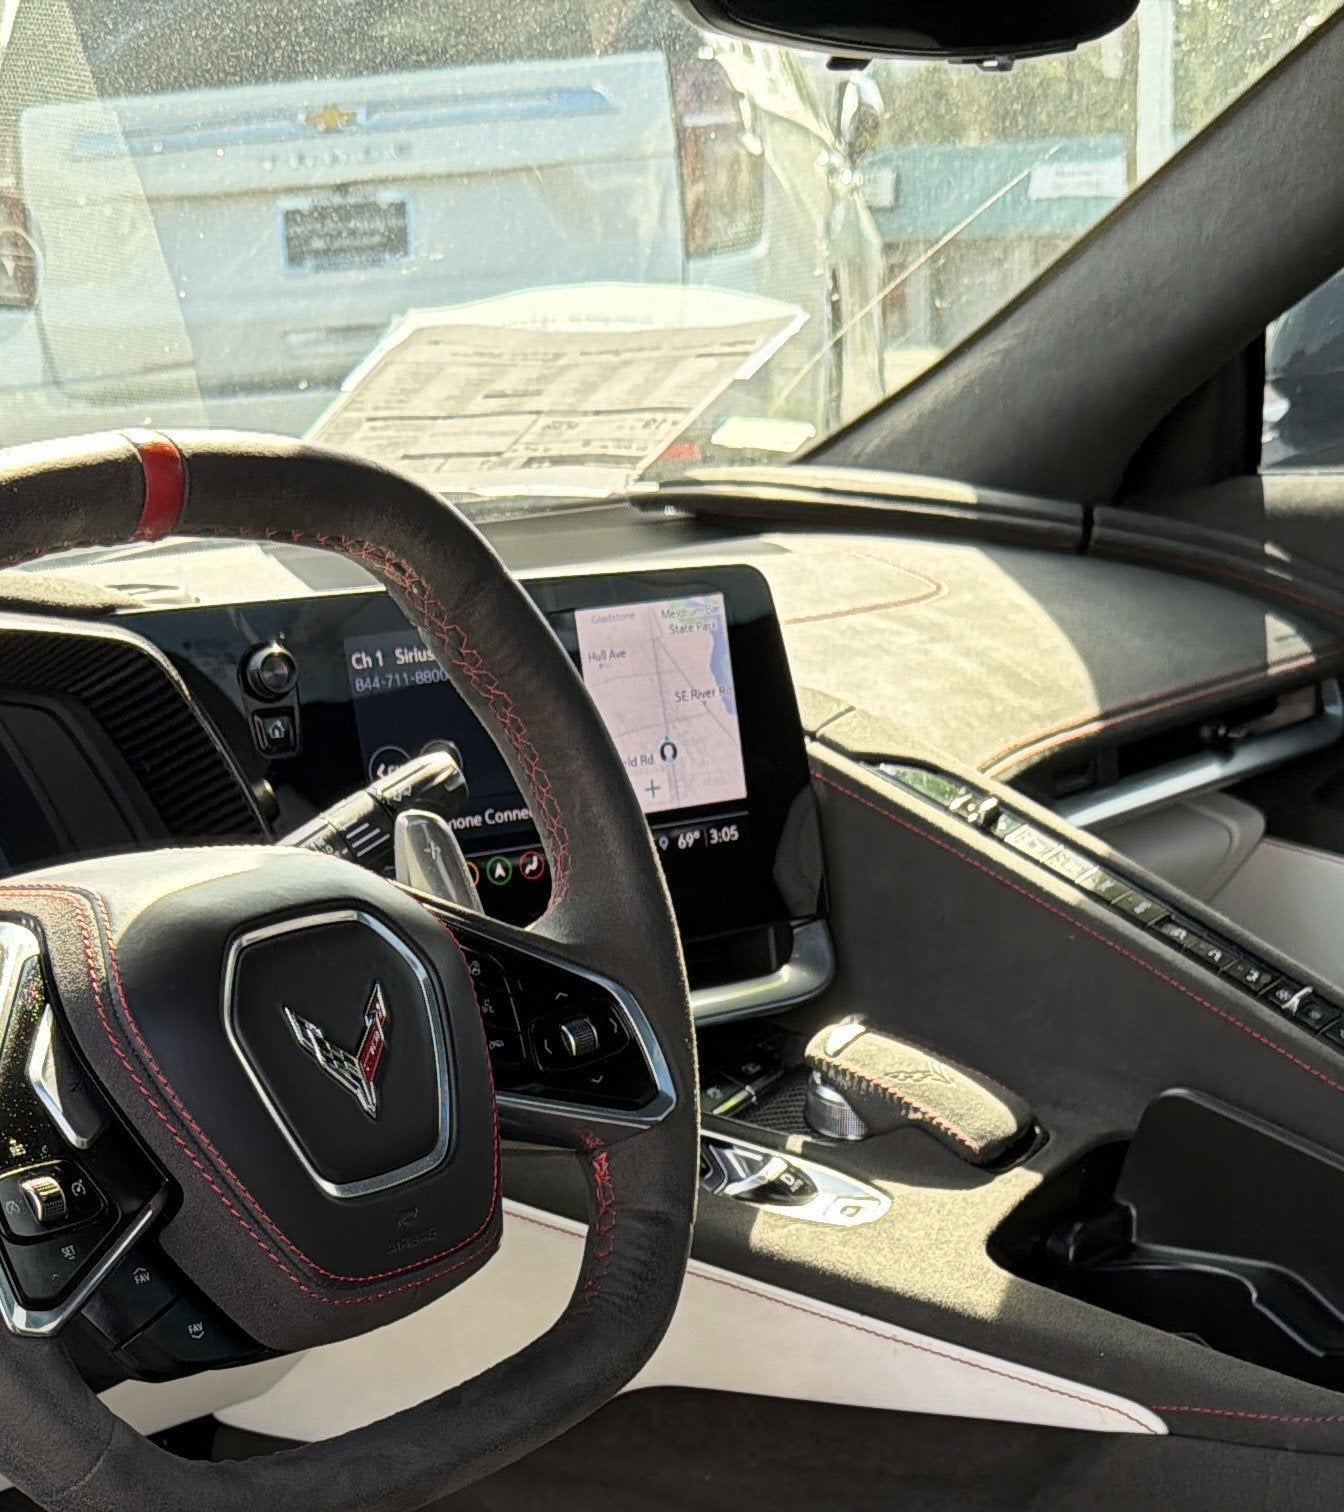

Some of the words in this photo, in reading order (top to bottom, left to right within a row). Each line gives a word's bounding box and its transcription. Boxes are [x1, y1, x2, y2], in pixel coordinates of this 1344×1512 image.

[669, 623, 694, 635] State
[351, 651, 372, 670] Ch
[376, 649, 384, 667] 1
[609, 649, 627, 660] Ave
[355, 668, 450, 692] 844-711-8800
[675, 690, 686, 703] SE
[691, 688, 716, 701] River
[640, 754, 654, 767] Rd
[709, 825, 739, 845] 3:05
[61, 1244, 76, 1258] SET
[133, 1272, 151, 1285] FAV
[188, 1321, 203, 1335] FAV
